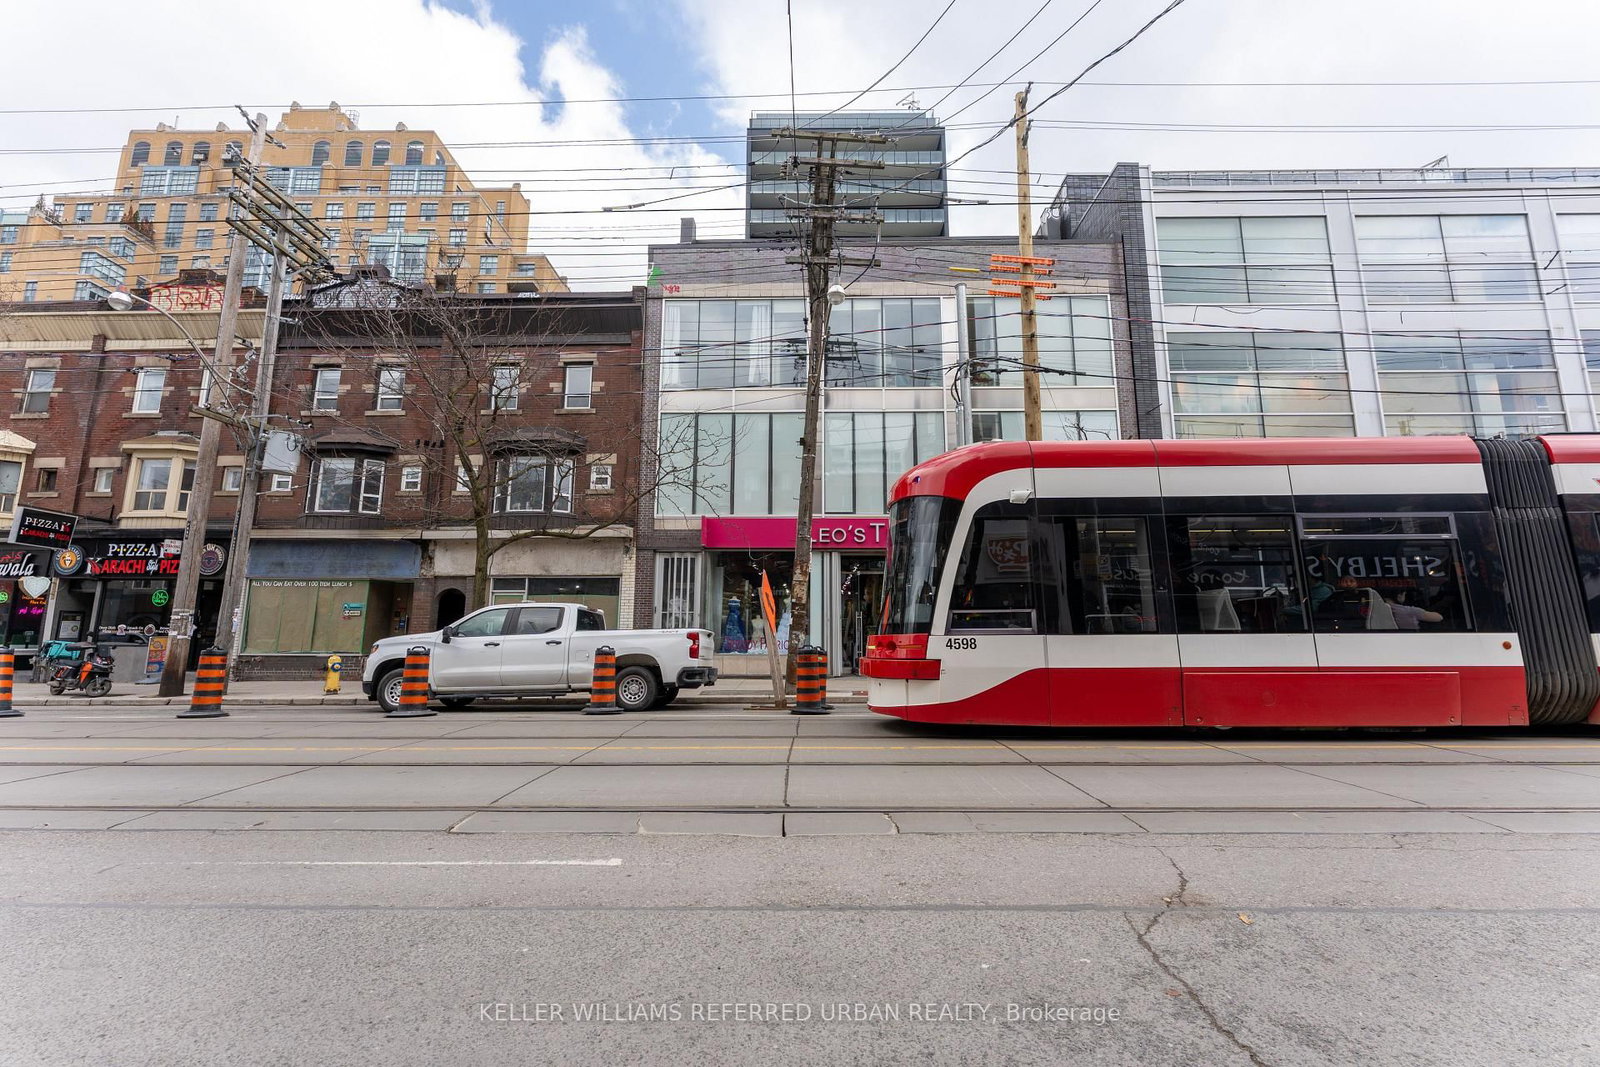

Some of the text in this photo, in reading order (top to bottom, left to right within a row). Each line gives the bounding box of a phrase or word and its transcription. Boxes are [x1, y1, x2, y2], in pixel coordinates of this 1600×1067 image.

[25, 517, 59, 530] PIZZA
[84, 557, 146, 574] KARACHI
[945, 637, 977, 650] 4598
